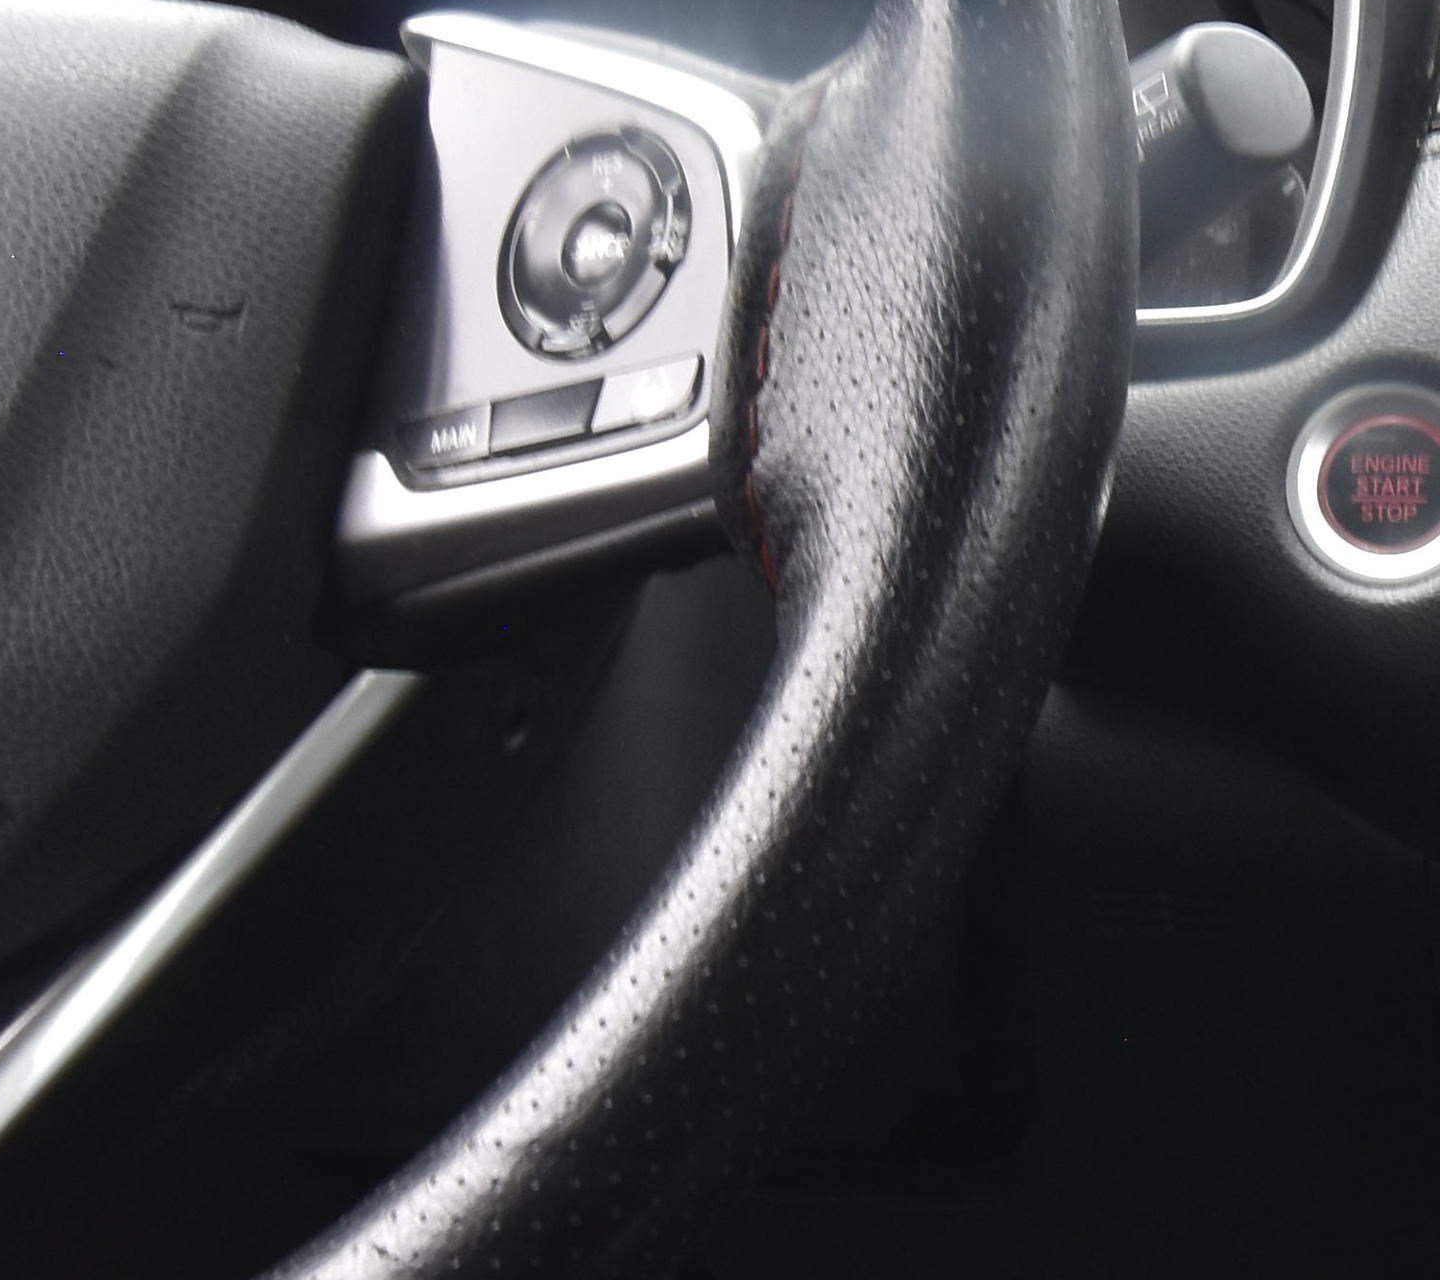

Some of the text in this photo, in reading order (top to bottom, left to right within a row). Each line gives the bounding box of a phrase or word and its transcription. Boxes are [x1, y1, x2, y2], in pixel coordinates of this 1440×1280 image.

[431, 421, 476, 455] MAIN
[1349, 453, 1431, 475] ENGINE
[1355, 475, 1424, 498] START
[1361, 503, 1418, 523] STOP
